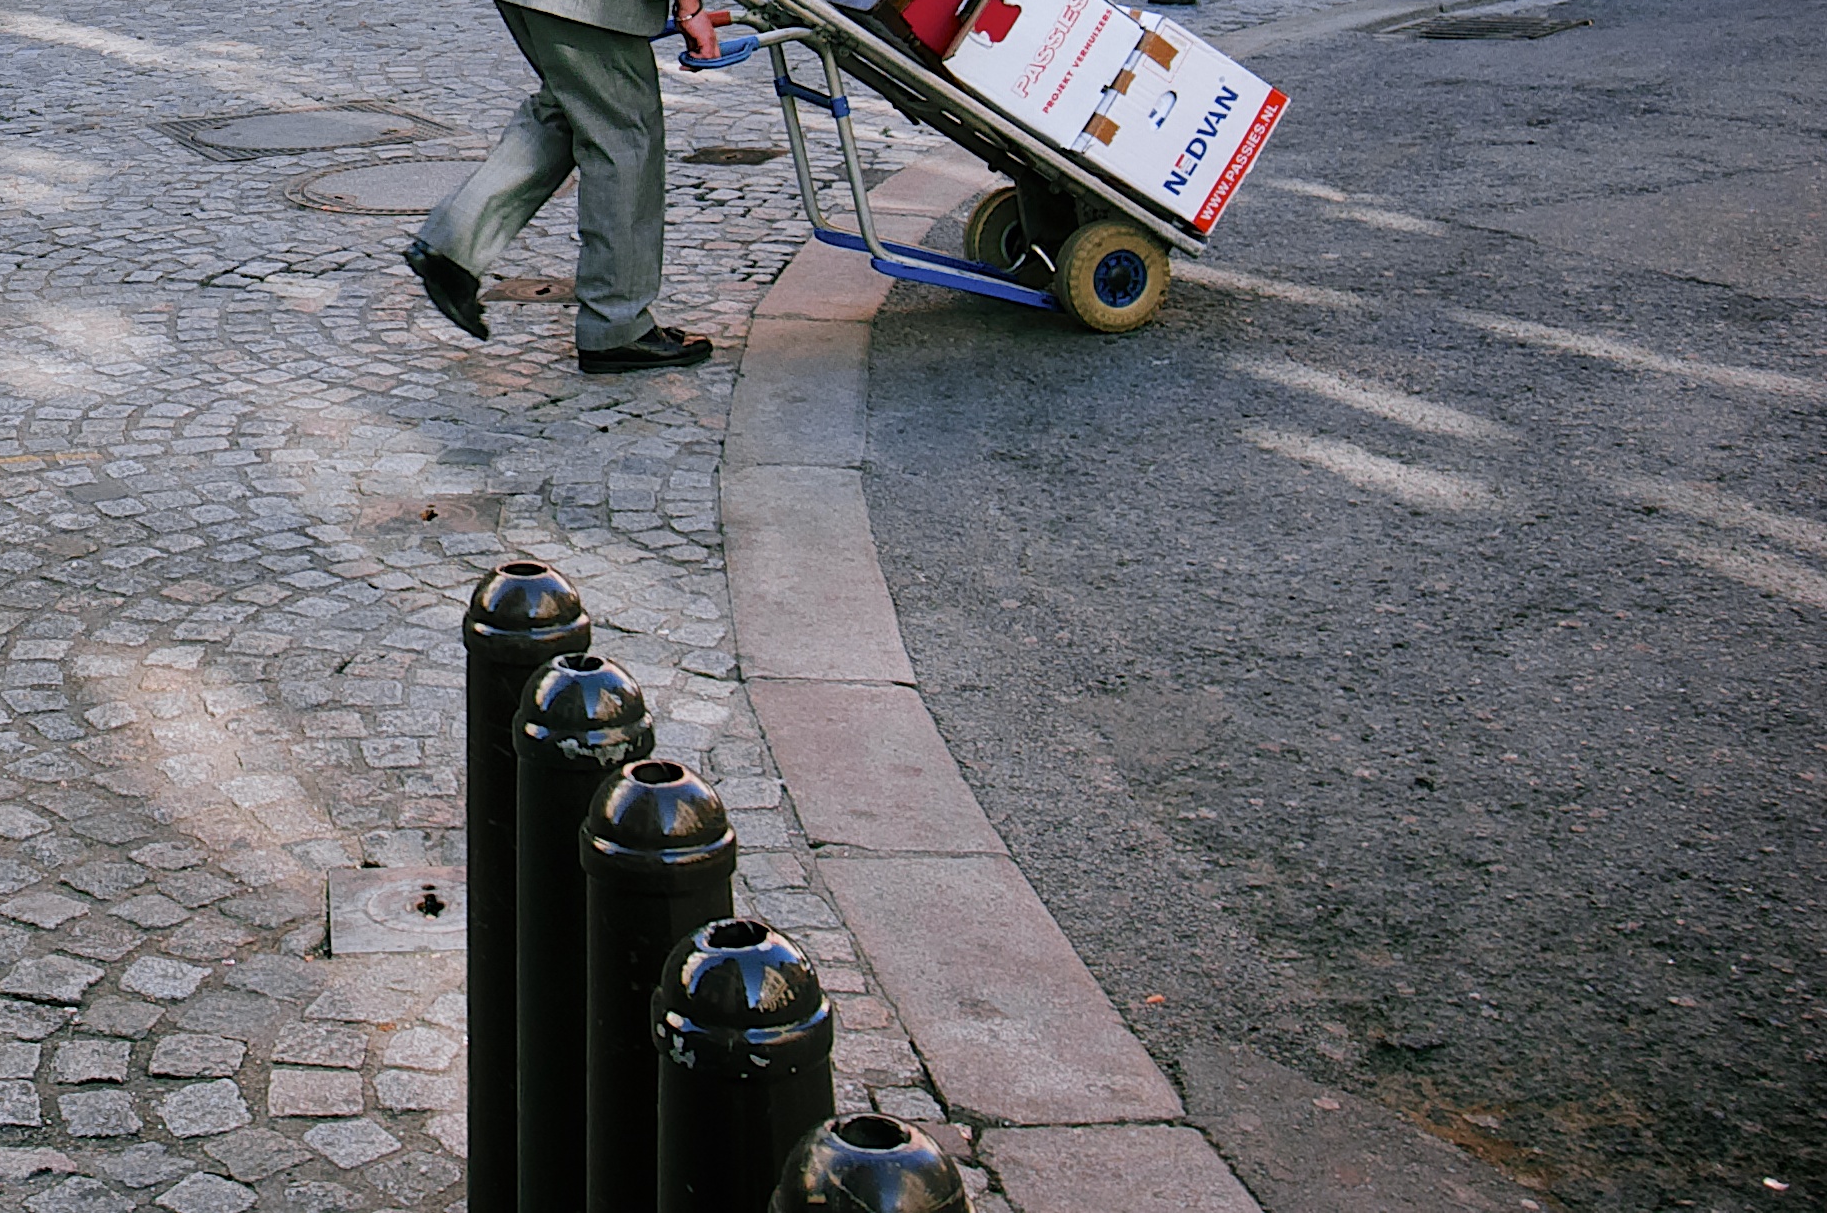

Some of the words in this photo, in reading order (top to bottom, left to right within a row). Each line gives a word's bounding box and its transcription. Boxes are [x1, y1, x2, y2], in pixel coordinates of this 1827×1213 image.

[1042, 70, 1073, 114] PROJEKT
[1072, 8, 1112, 67] VERHUIZERS
[1162, 84, 1240, 197] NEDVAN
[1200, 102, 1279, 222] WWW.PASSIES.NL
